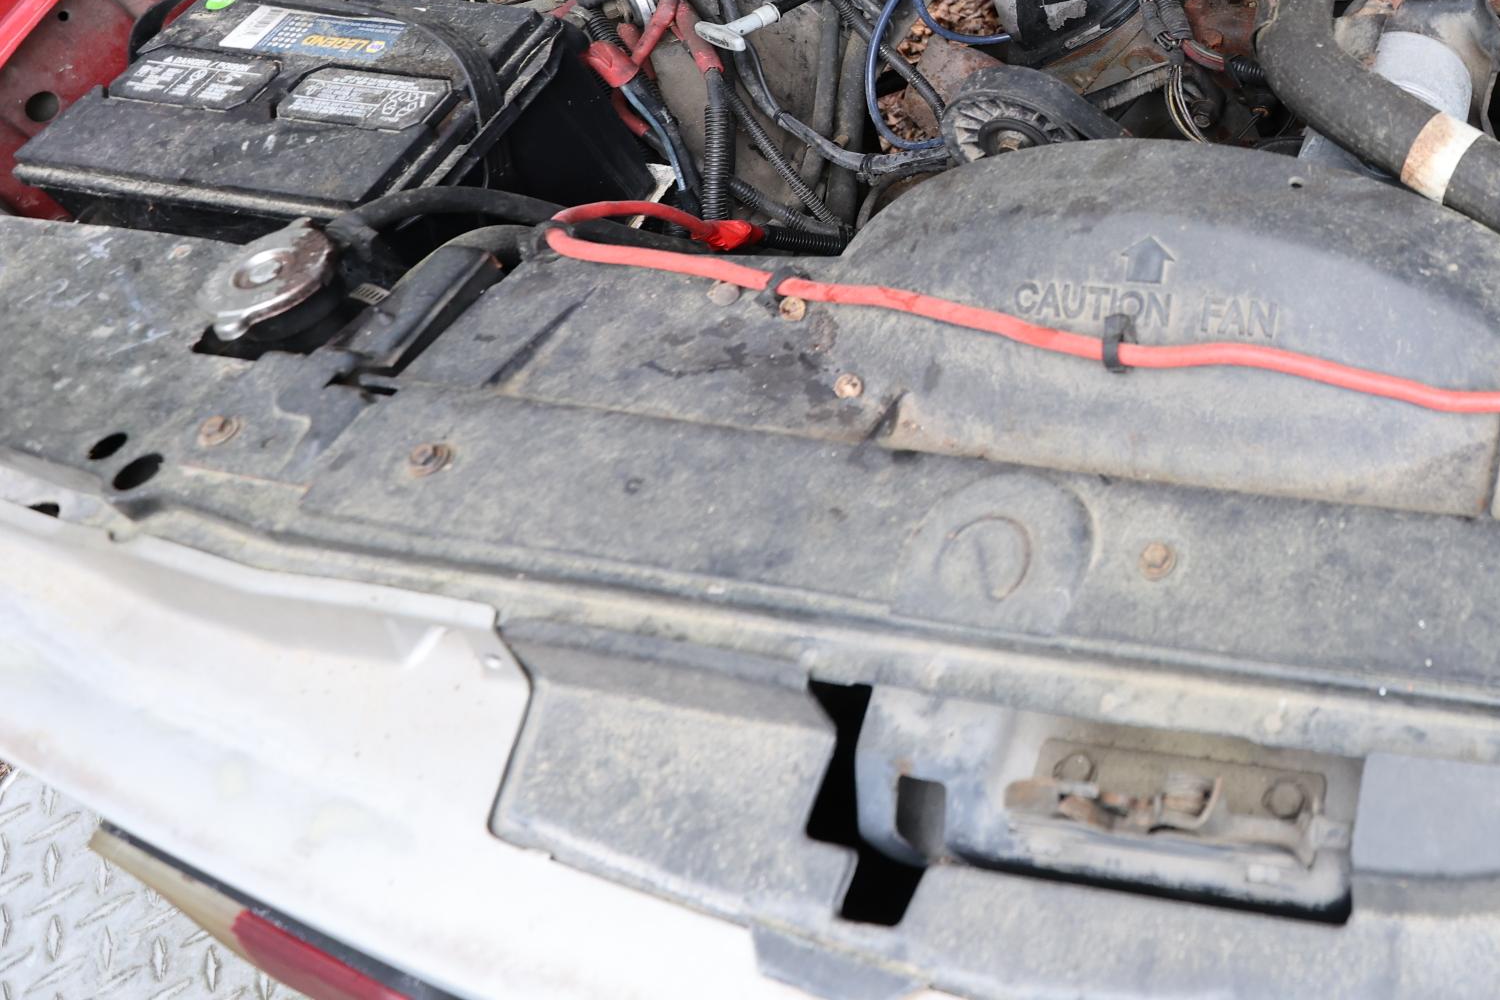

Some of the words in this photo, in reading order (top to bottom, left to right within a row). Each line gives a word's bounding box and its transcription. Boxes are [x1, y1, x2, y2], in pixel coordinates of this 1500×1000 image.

[302, 34, 371, 51] LEGEND
[1014, 281, 1172, 328] CAUTION
[1201, 296, 1278, 338] FAN
